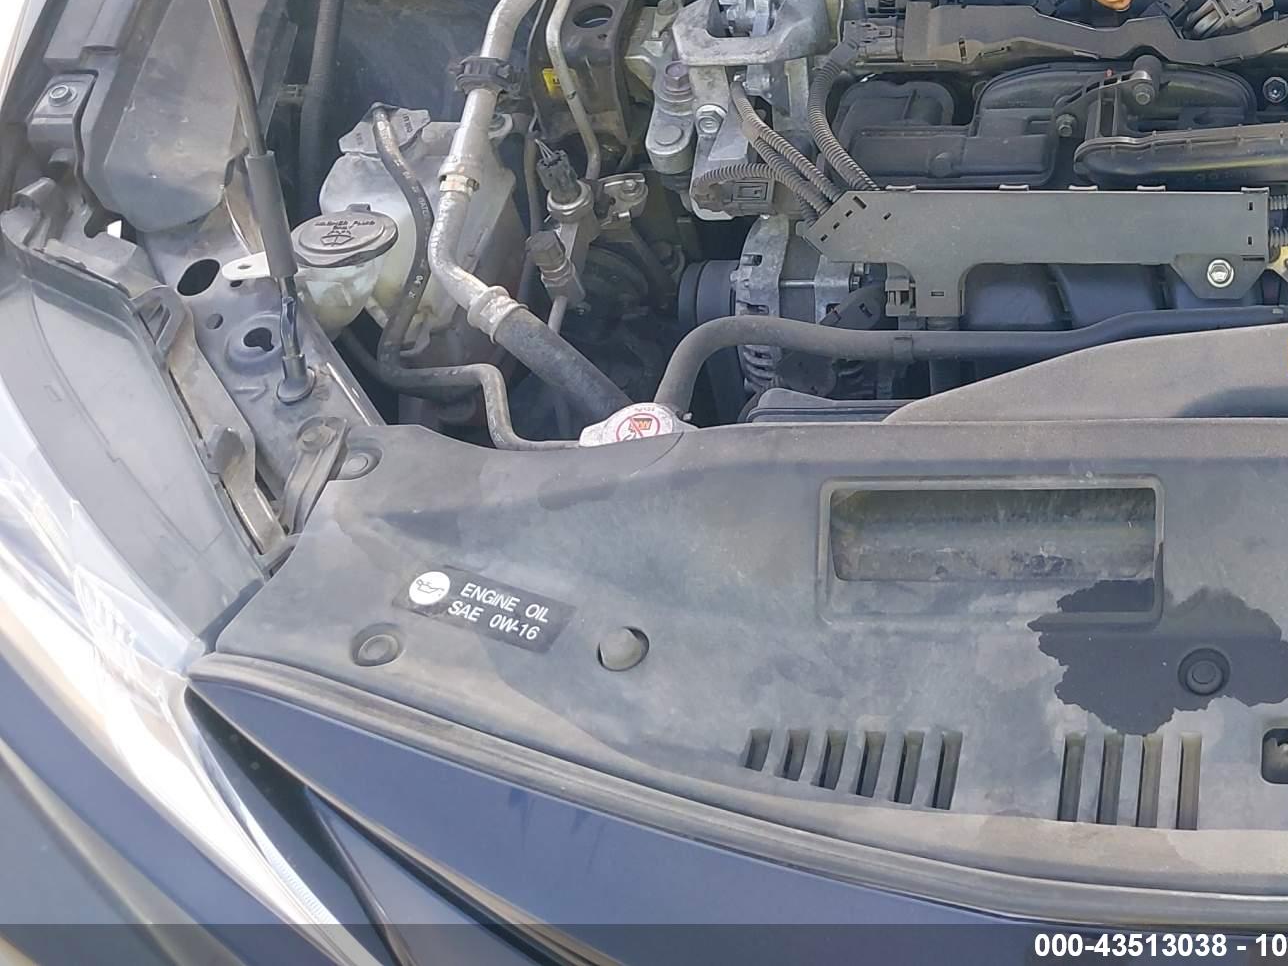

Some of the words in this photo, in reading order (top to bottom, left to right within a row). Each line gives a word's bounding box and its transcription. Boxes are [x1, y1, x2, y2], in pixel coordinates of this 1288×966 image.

[448, 600, 484, 622] SAE
[489, 614, 541, 640] 0W-16
[460, 582, 521, 612] ENGINE
[525, 603, 550, 623] OIL
